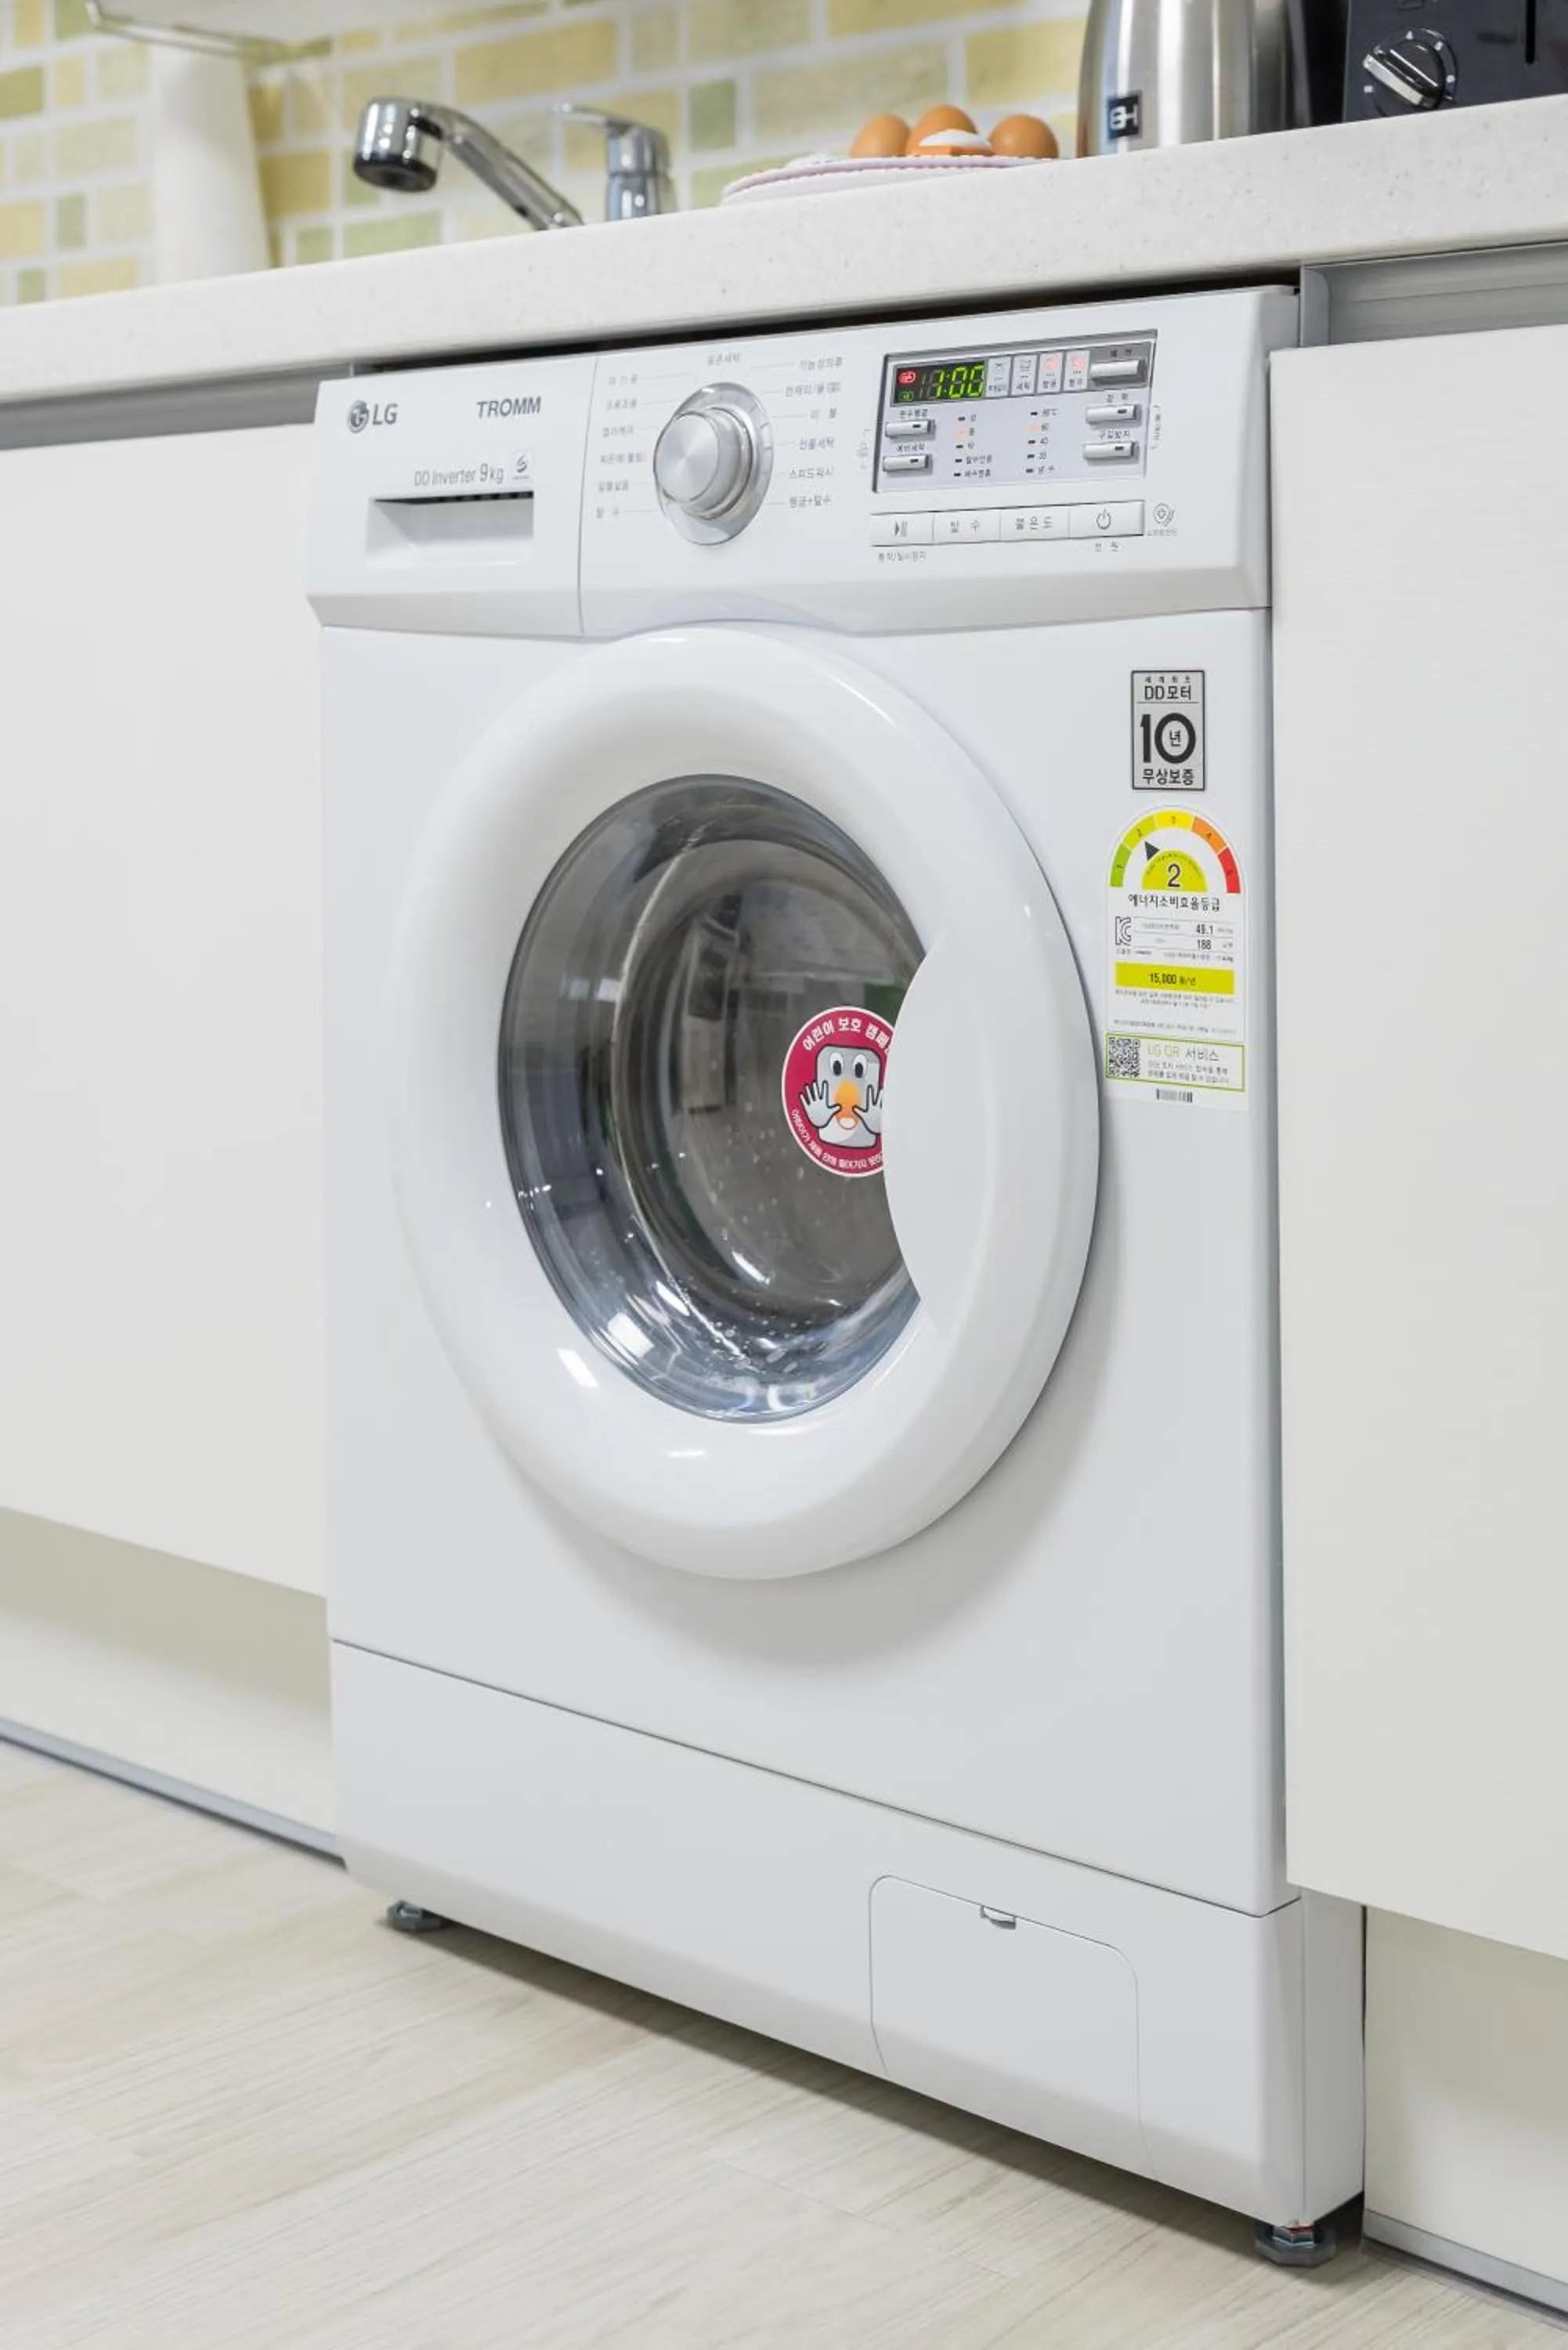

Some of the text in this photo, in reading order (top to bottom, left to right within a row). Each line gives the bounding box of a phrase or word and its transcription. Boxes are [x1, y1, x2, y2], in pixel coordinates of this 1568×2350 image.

[372, 403, 399, 425] LG
[476, 396, 542, 419] TROMM
[432, 468, 476, 485] Inverter
[1144, 685, 1191, 701] DD모터
[1140, 713, 1196, 764] 10
[1169, 729, 1181, 747] 년
[1143, 768, 1194, 786] 무상보증
[1167, 862, 1180, 888] 2
[1128, 894, 1220, 913] 에너지소비효율등급
[802, 1019, 835, 1051] 어린이
[837, 1017, 862, 1032] 보호
[1185, 1047, 1220, 1062] 서비스
